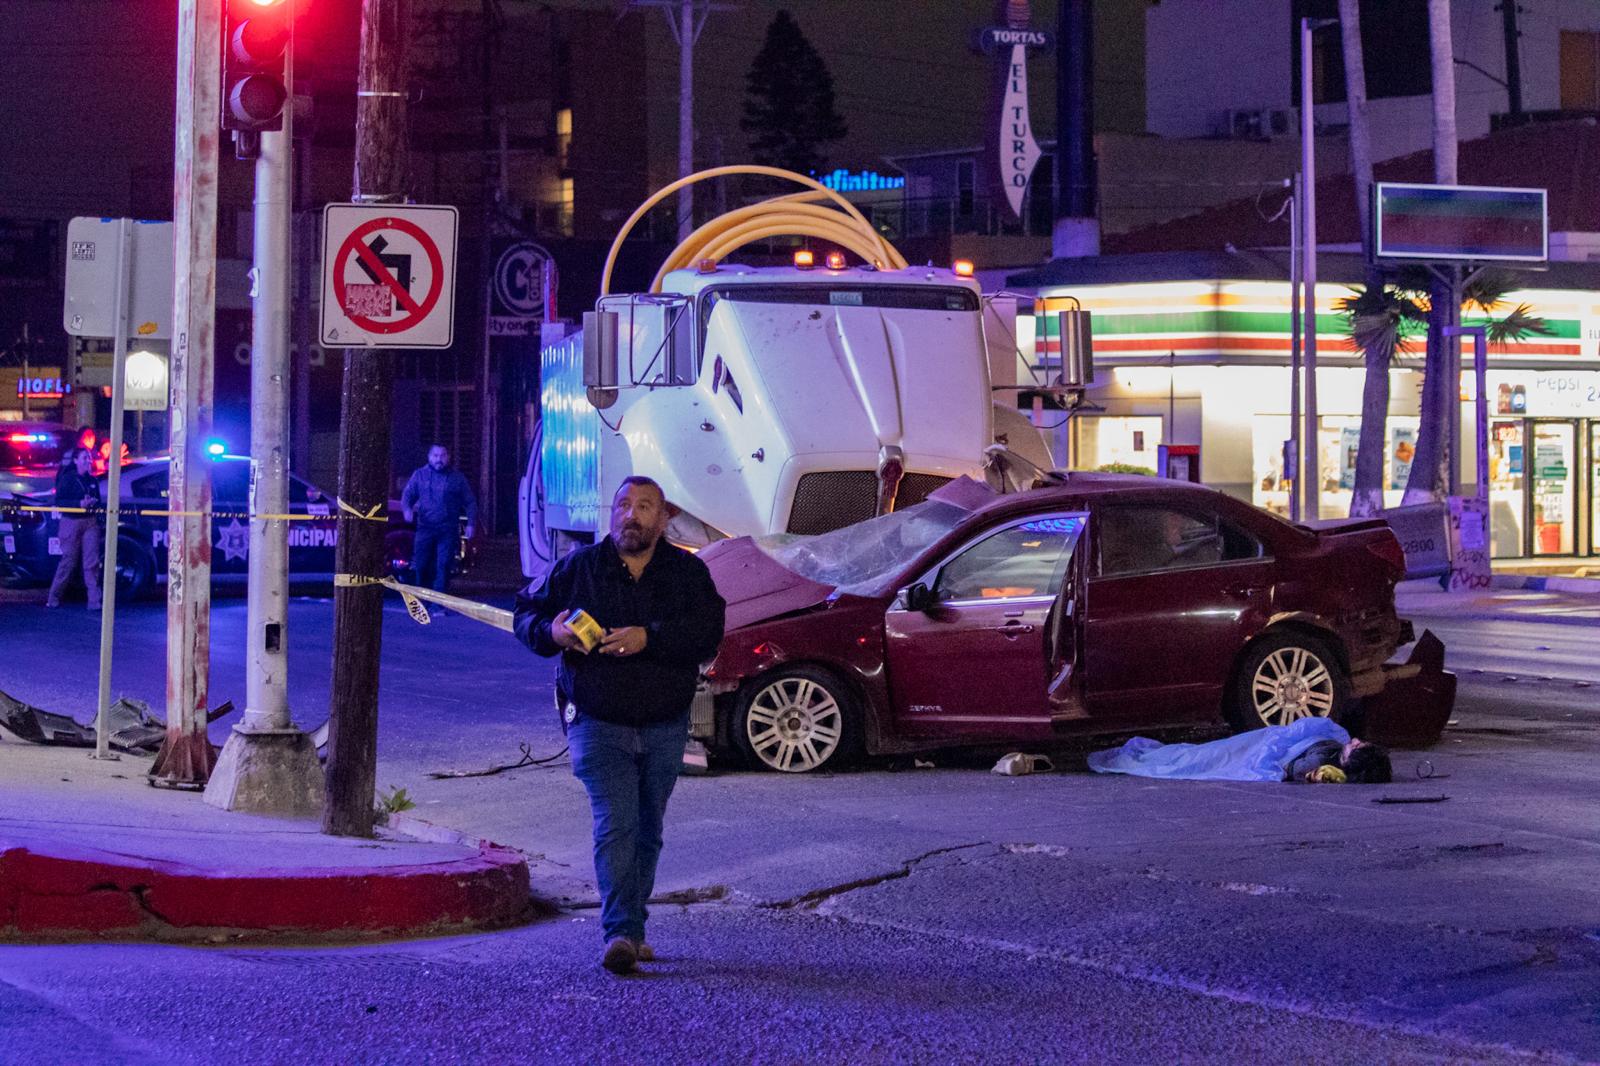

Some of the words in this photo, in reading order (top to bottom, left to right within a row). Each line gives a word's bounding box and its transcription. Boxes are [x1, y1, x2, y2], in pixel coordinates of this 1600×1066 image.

[993, 30, 1046, 45] TORTAS
[1012, 64, 1024, 94] EL
[1011, 106, 1027, 188] TURCO
